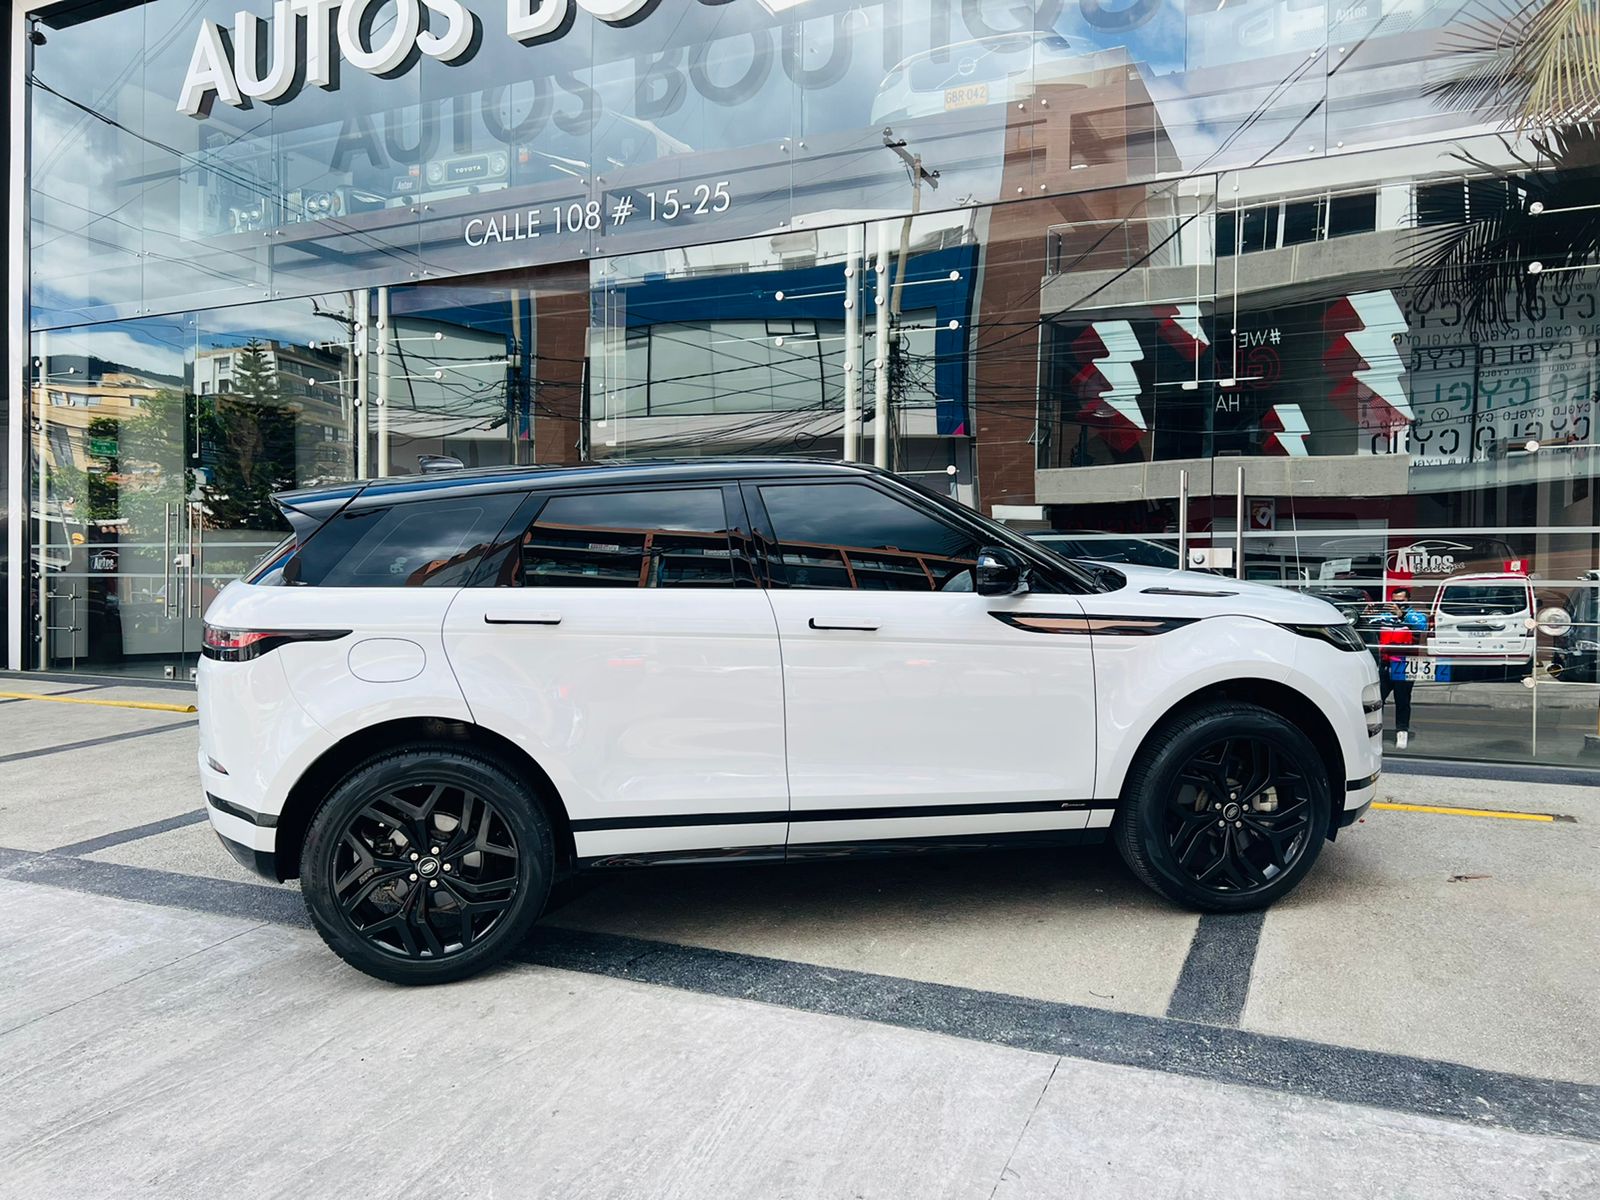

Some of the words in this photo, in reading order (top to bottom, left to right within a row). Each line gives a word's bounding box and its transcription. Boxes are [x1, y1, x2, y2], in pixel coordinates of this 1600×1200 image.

[176, 0, 474, 120] AUTOS
[455, 165, 481, 174] TOYOTA
[465, 209, 541, 247] CALLE
[553, 200, 601, 234] 108
[612, 195, 633, 226] #
[646, 181, 731, 221] 15-25
[1394, 548, 1454, 573] Autos
